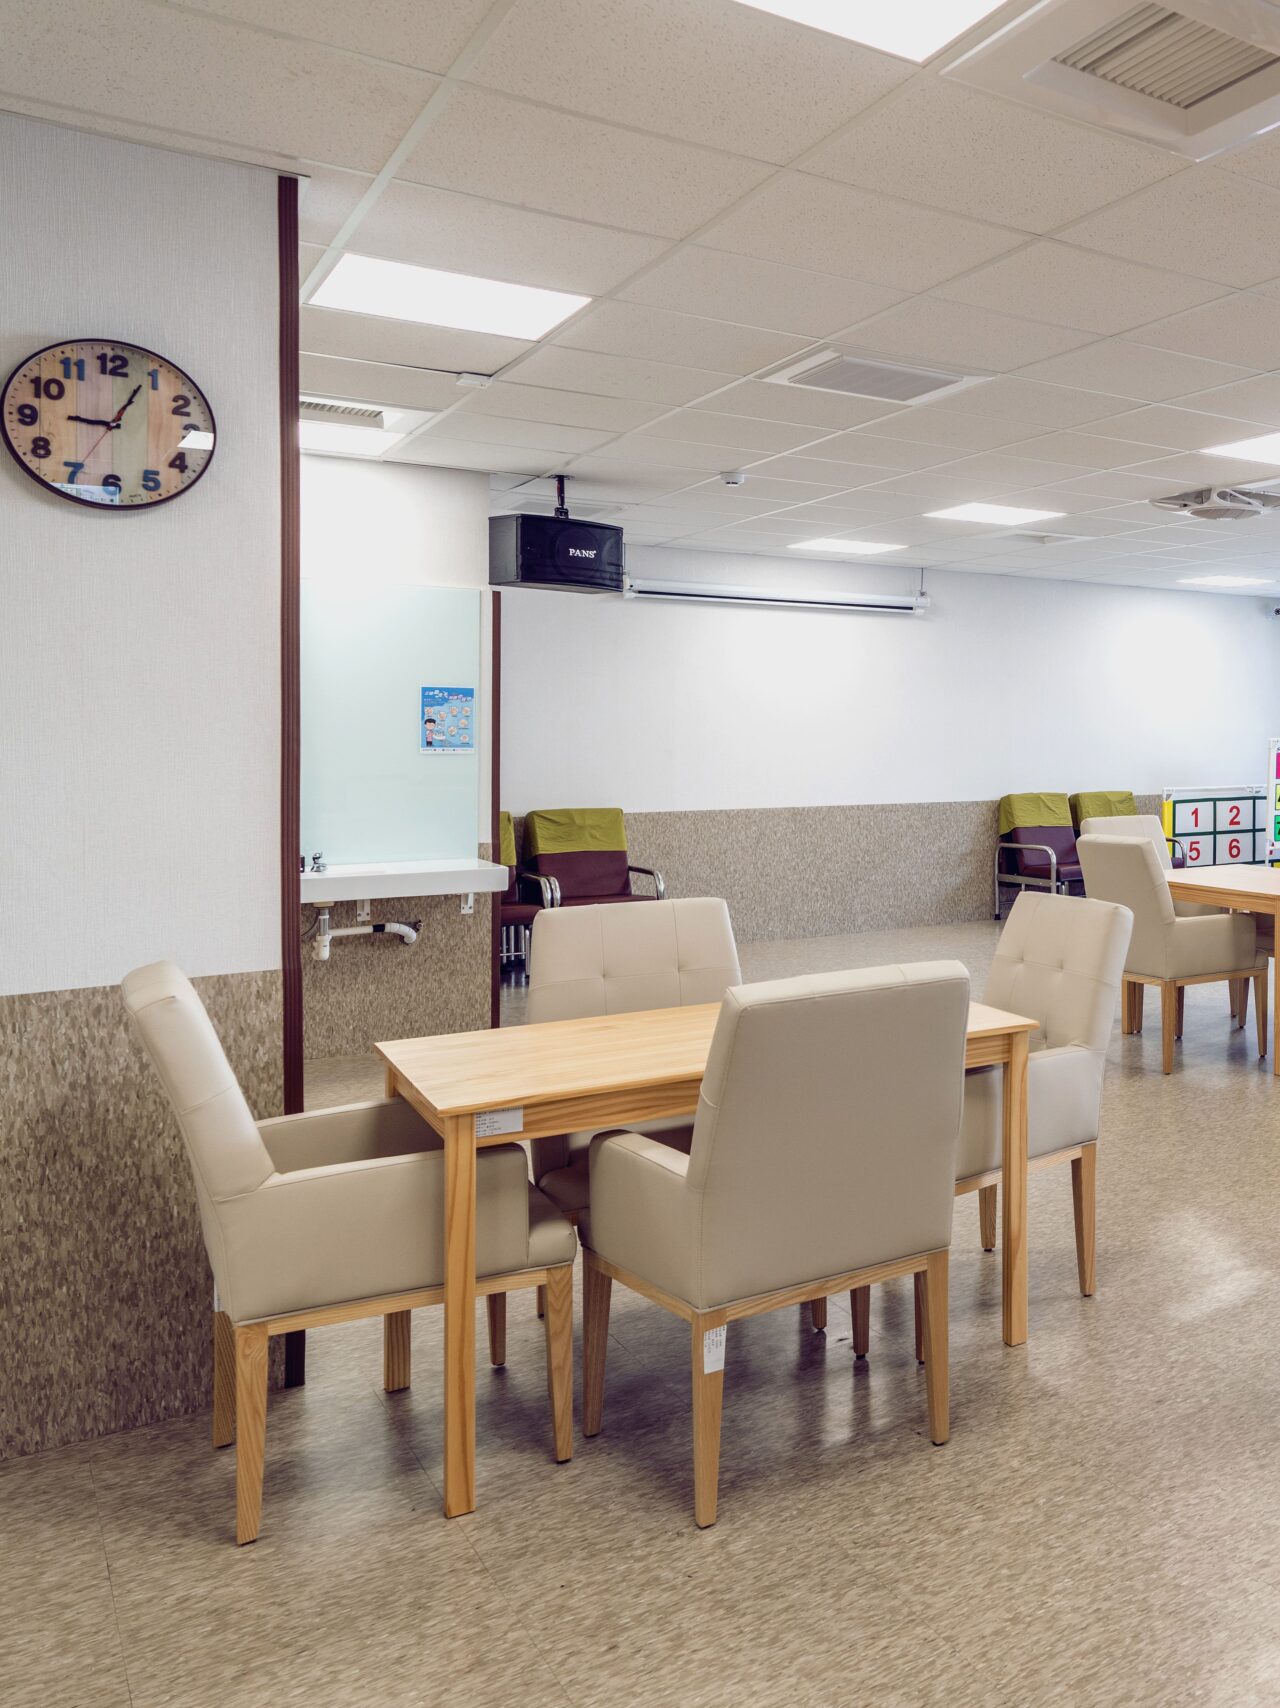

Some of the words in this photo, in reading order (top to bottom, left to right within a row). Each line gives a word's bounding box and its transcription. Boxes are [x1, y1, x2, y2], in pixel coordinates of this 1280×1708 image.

[60, 357, 85, 381] 11
[96, 353, 129, 377] 12
[30, 376, 65, 400] 10
[147, 369, 159, 390] 1
[17, 404, 38, 426] 9
[172, 395, 191, 417] 2
[31, 436, 51, 458] 8
[63, 461, 84, 484] 7
[168, 452, 188, 473] 4
[102, 474, 122, 495] 6
[142, 470, 161, 491] 5
[568, 548, 595, 558] PANS
[1191, 807, 1199, 827] 1
[1228, 805, 1241, 825] 2
[1188, 841, 1201, 861] 5
[1228, 838, 1241, 858] 6
